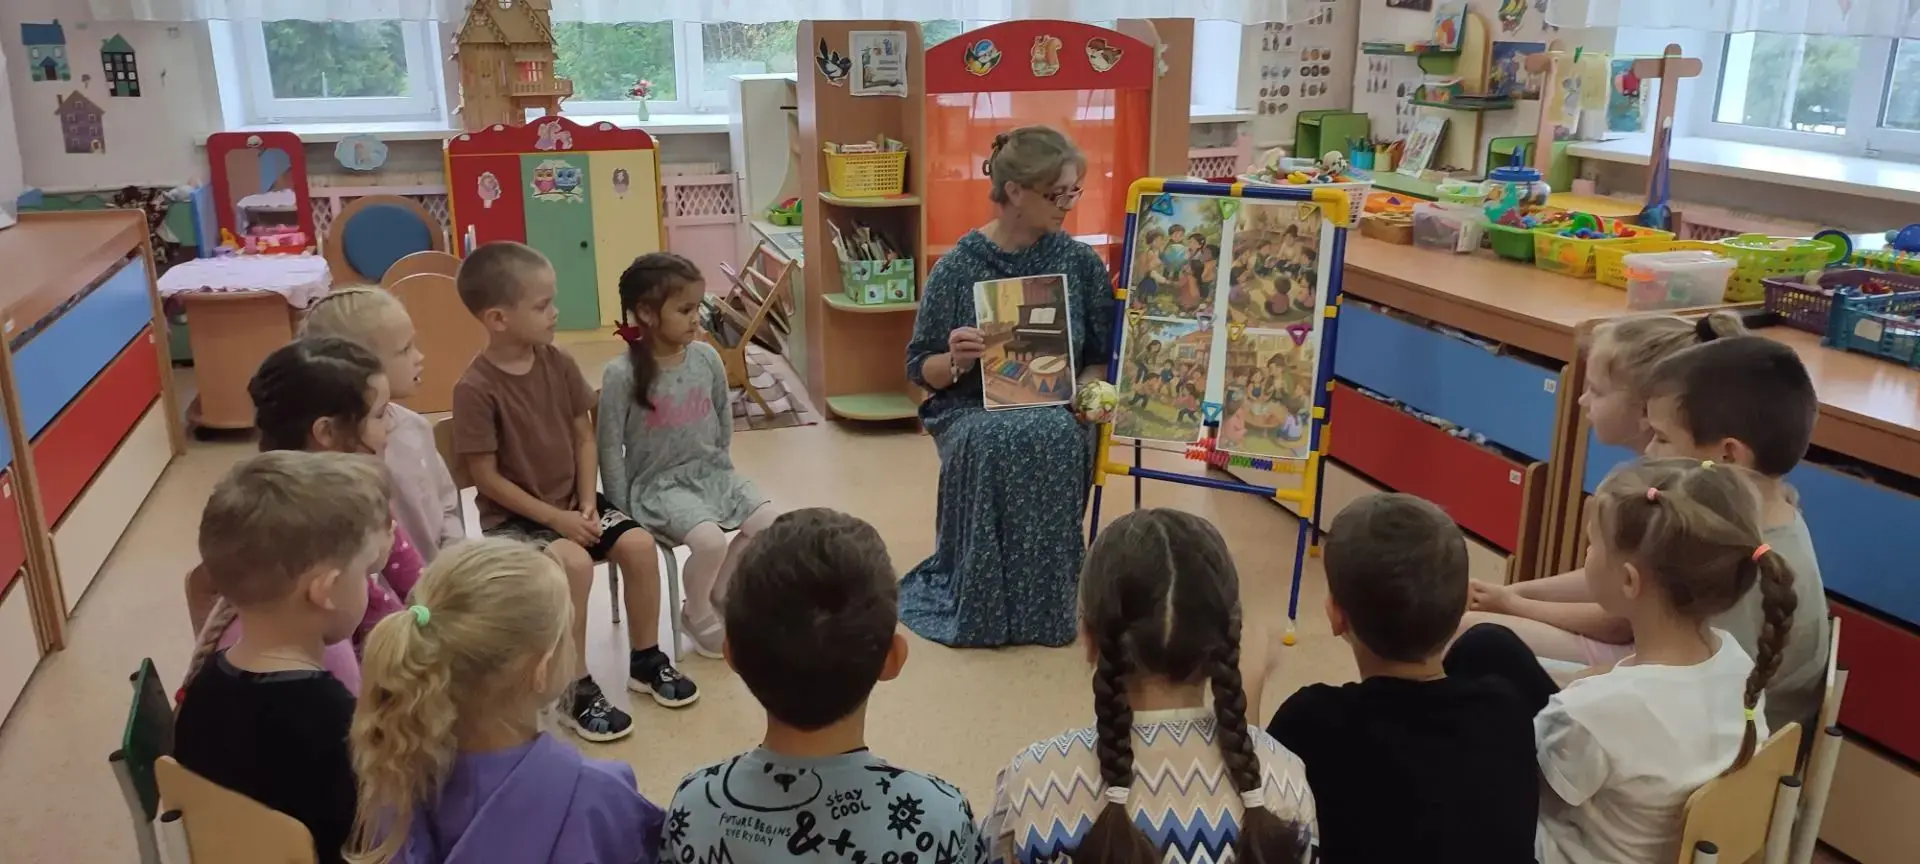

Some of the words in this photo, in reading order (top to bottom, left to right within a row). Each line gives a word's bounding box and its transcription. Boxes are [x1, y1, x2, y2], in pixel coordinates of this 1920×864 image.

[831, 799, 872, 820] COOL
[719, 812, 753, 828] FUTURE
[753, 817, 792, 836] BEGINS
